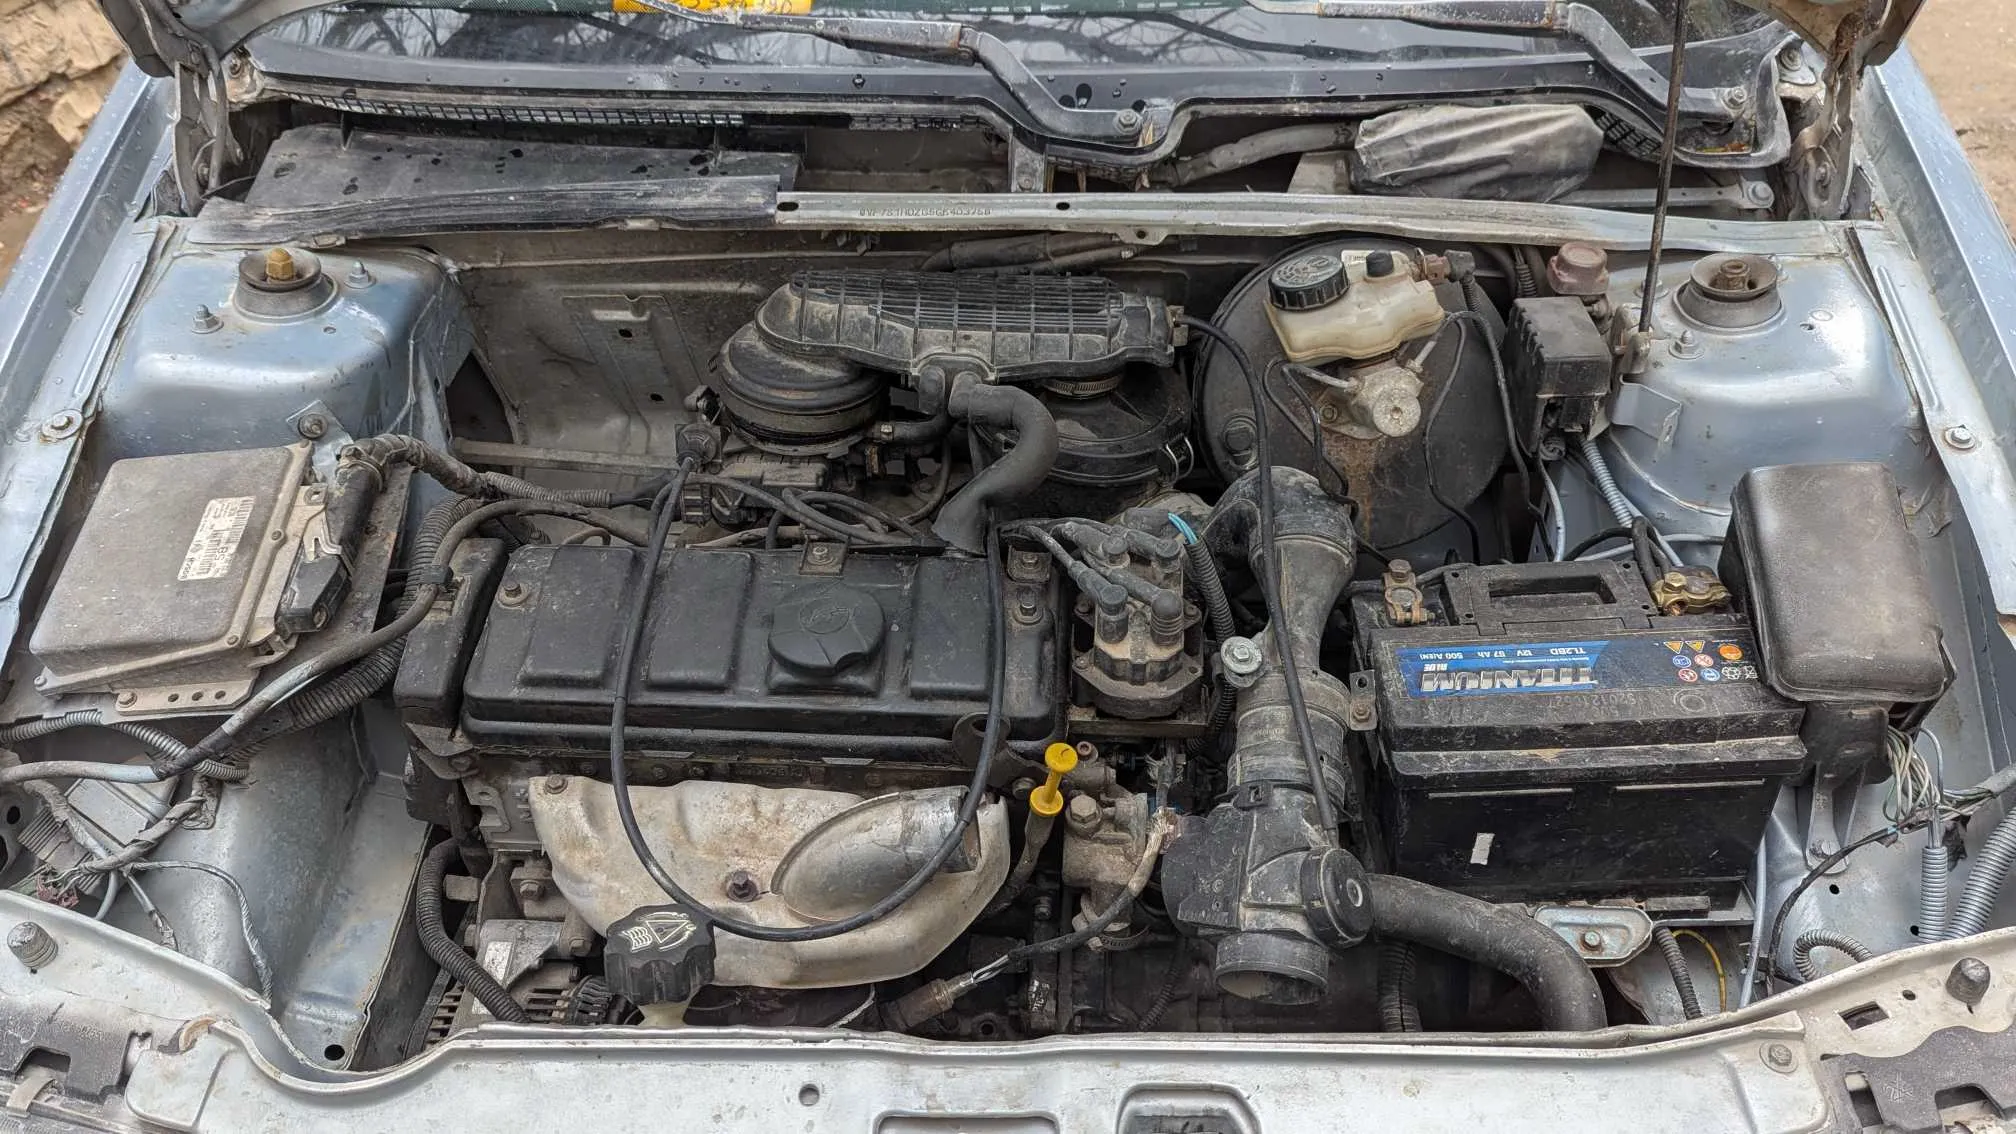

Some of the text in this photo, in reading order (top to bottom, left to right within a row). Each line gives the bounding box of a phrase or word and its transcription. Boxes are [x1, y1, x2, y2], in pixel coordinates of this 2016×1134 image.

[1419, 652, 1443, 660] A(EN)
[1445, 652, 1464, 660] 500
[1477, 650, 1490, 658] Ah
[1517, 649, 1533, 657] 12V
[1421, 668, 1598, 691] TITANIUM
